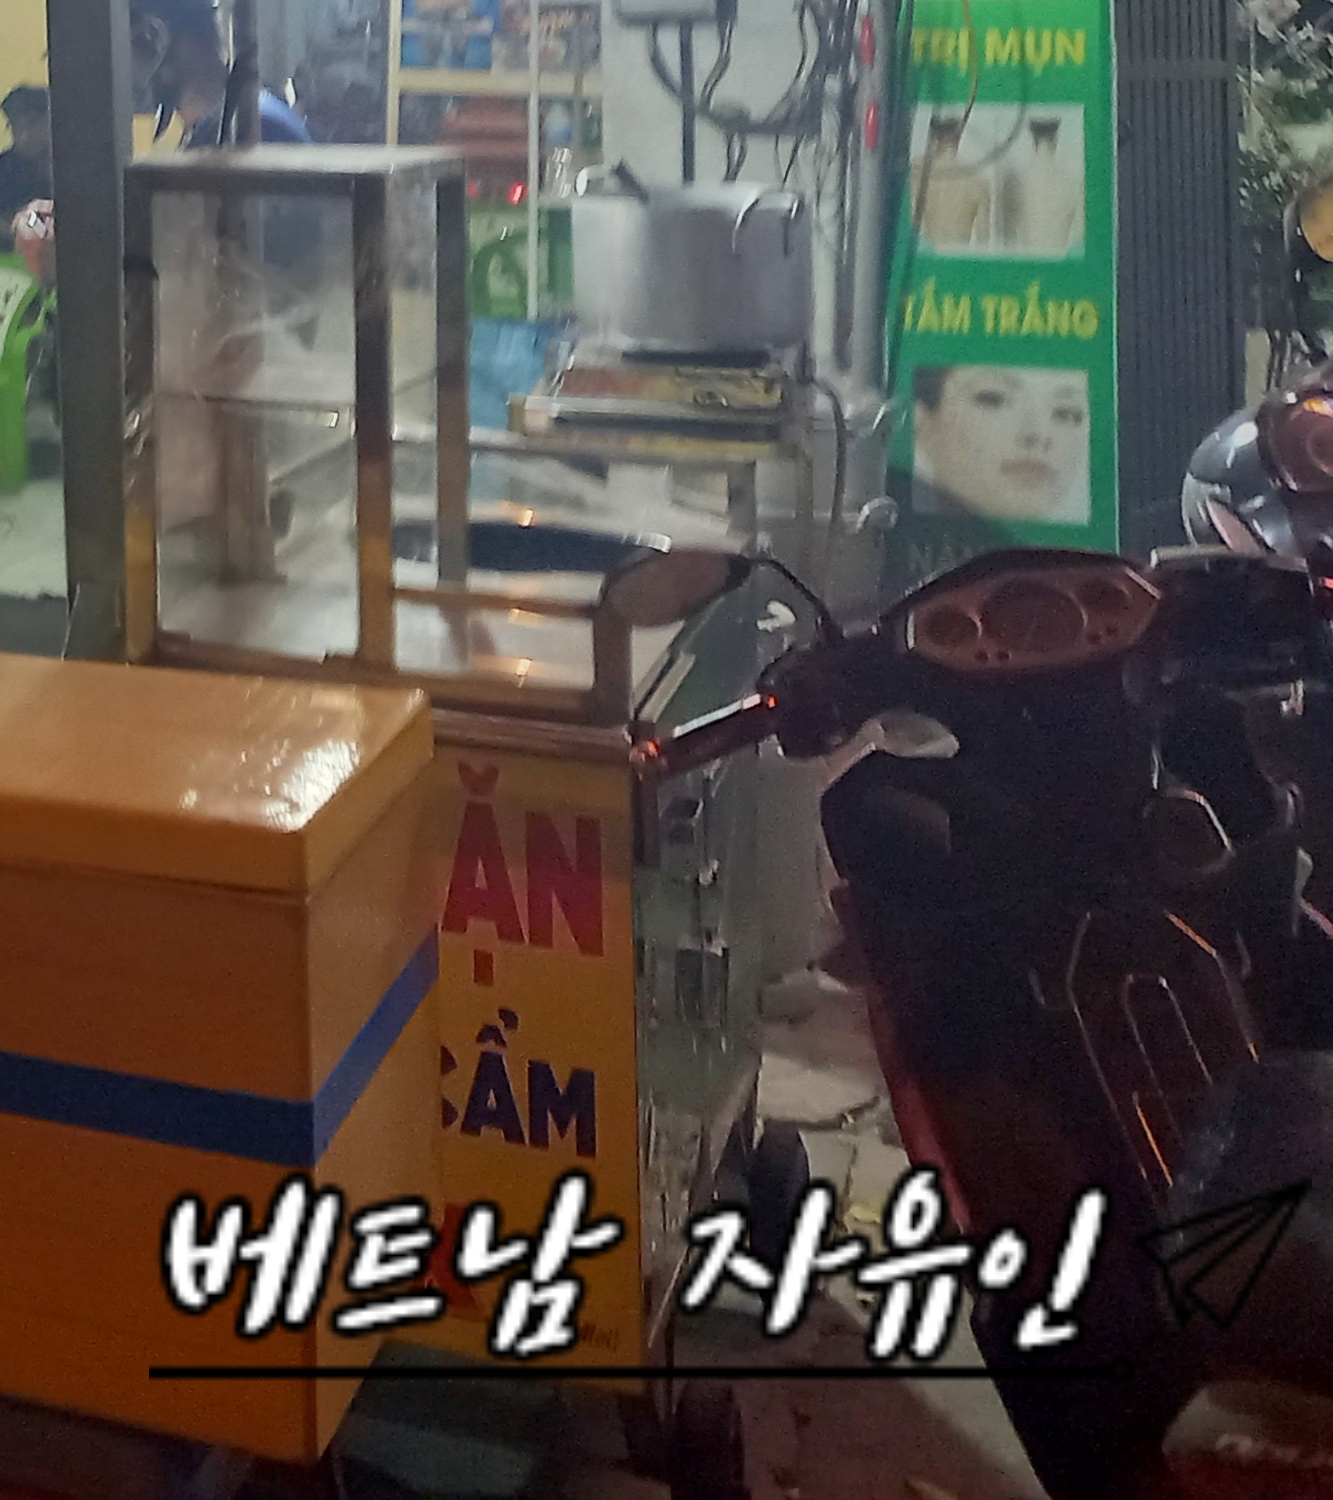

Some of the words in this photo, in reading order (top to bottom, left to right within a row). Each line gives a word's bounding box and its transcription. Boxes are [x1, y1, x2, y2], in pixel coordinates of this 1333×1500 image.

[985, 27, 1086, 77] MỤN
[441, 761, 603, 987] ẶN
[440, 1006, 597, 1157] ẨM
